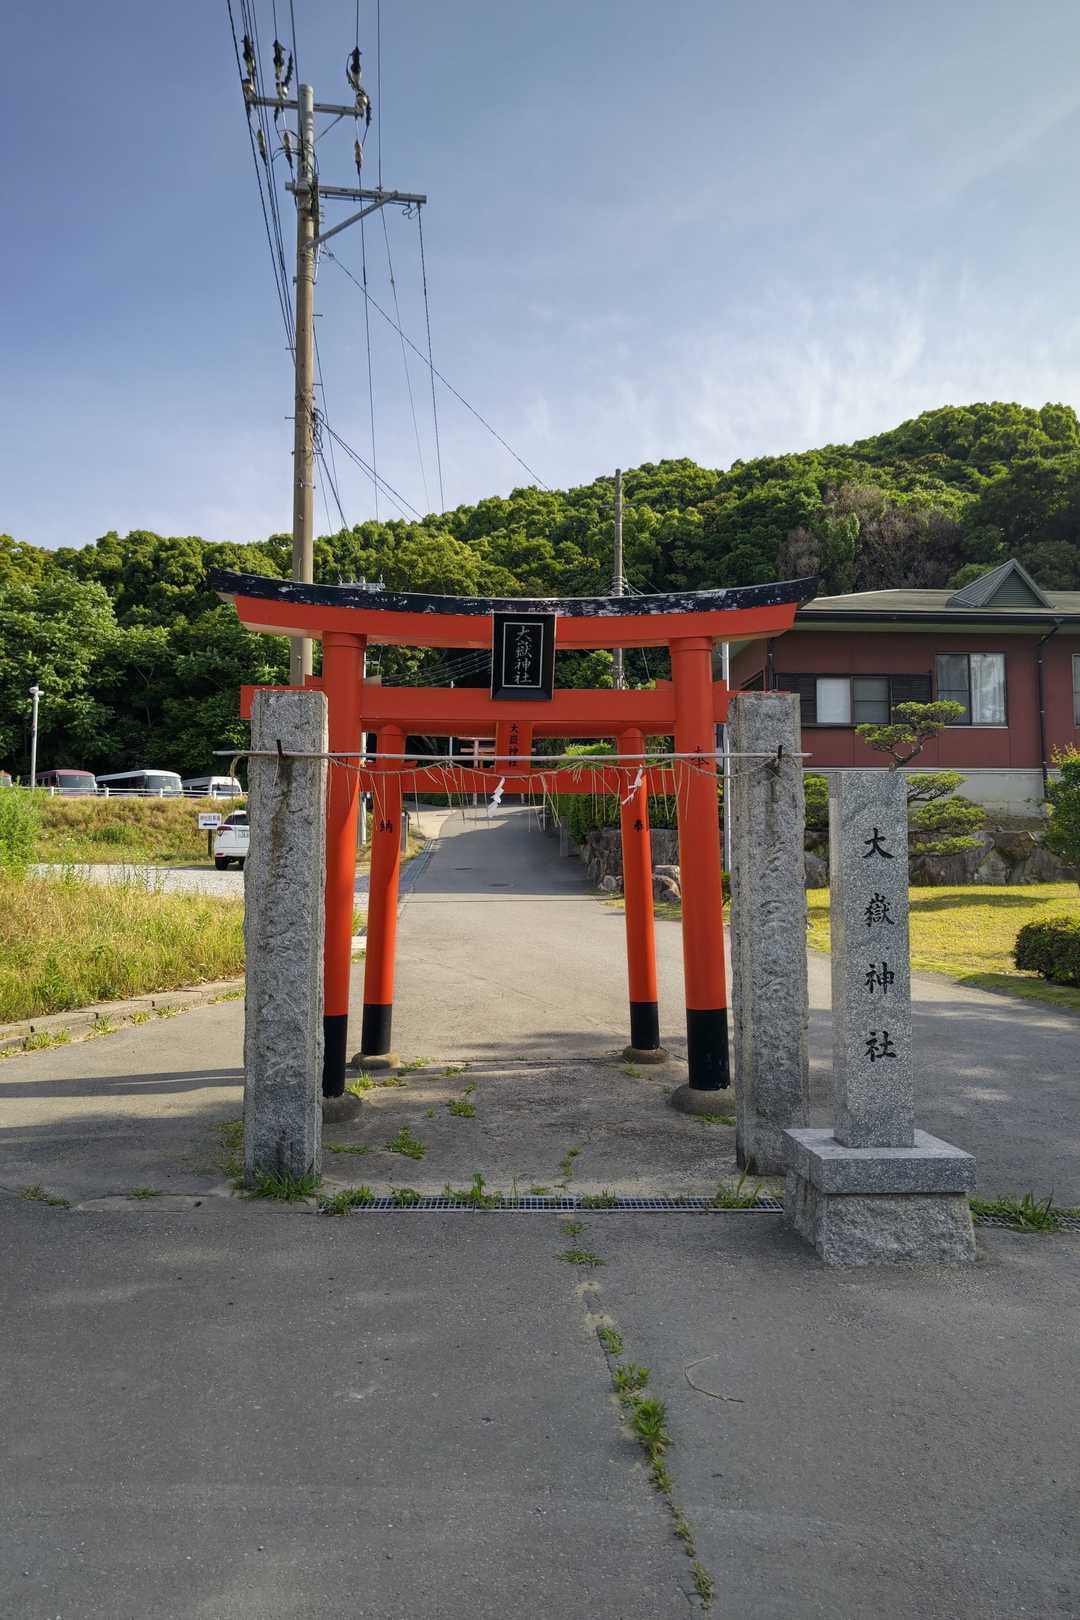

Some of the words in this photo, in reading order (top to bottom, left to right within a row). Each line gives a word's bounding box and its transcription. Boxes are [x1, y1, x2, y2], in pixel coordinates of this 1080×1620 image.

[512, 625, 533, 685] 大嶽神社
[862, 827, 897, 1063] 大嶽神社
